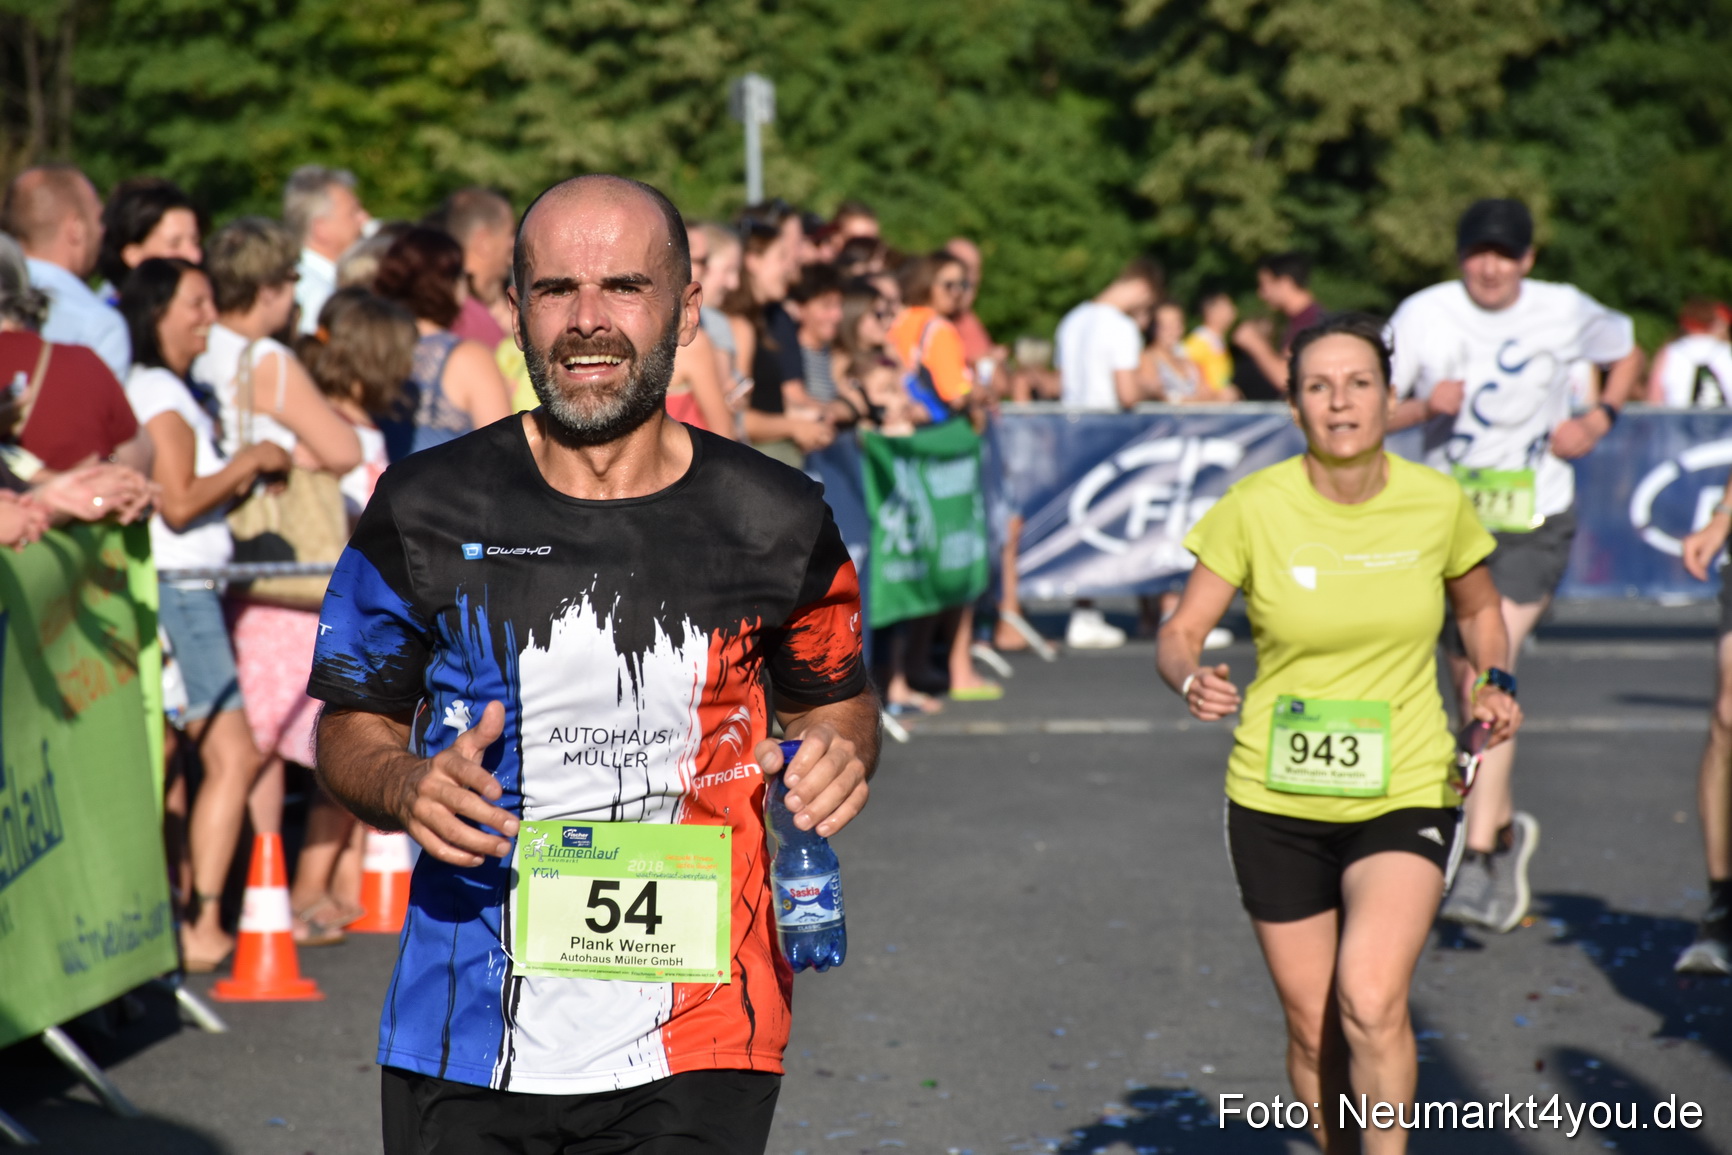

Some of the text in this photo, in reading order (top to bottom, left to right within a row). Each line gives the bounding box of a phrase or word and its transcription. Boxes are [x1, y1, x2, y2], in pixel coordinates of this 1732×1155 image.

[549, 727, 668, 746] AUTOHAUS
[563, 747, 648, 768] MÜLLER
[1289, 732, 1360, 767] 943
[547, 844, 620, 861] firmenlauf
[627, 860, 664, 872] 2018
[789, 886, 821, 898] Saskia
[584, 879, 663, 935] 54
[570, 936, 676, 953] Plank Werner
[560, 952, 683, 966] Autohaus Müller GmbH
